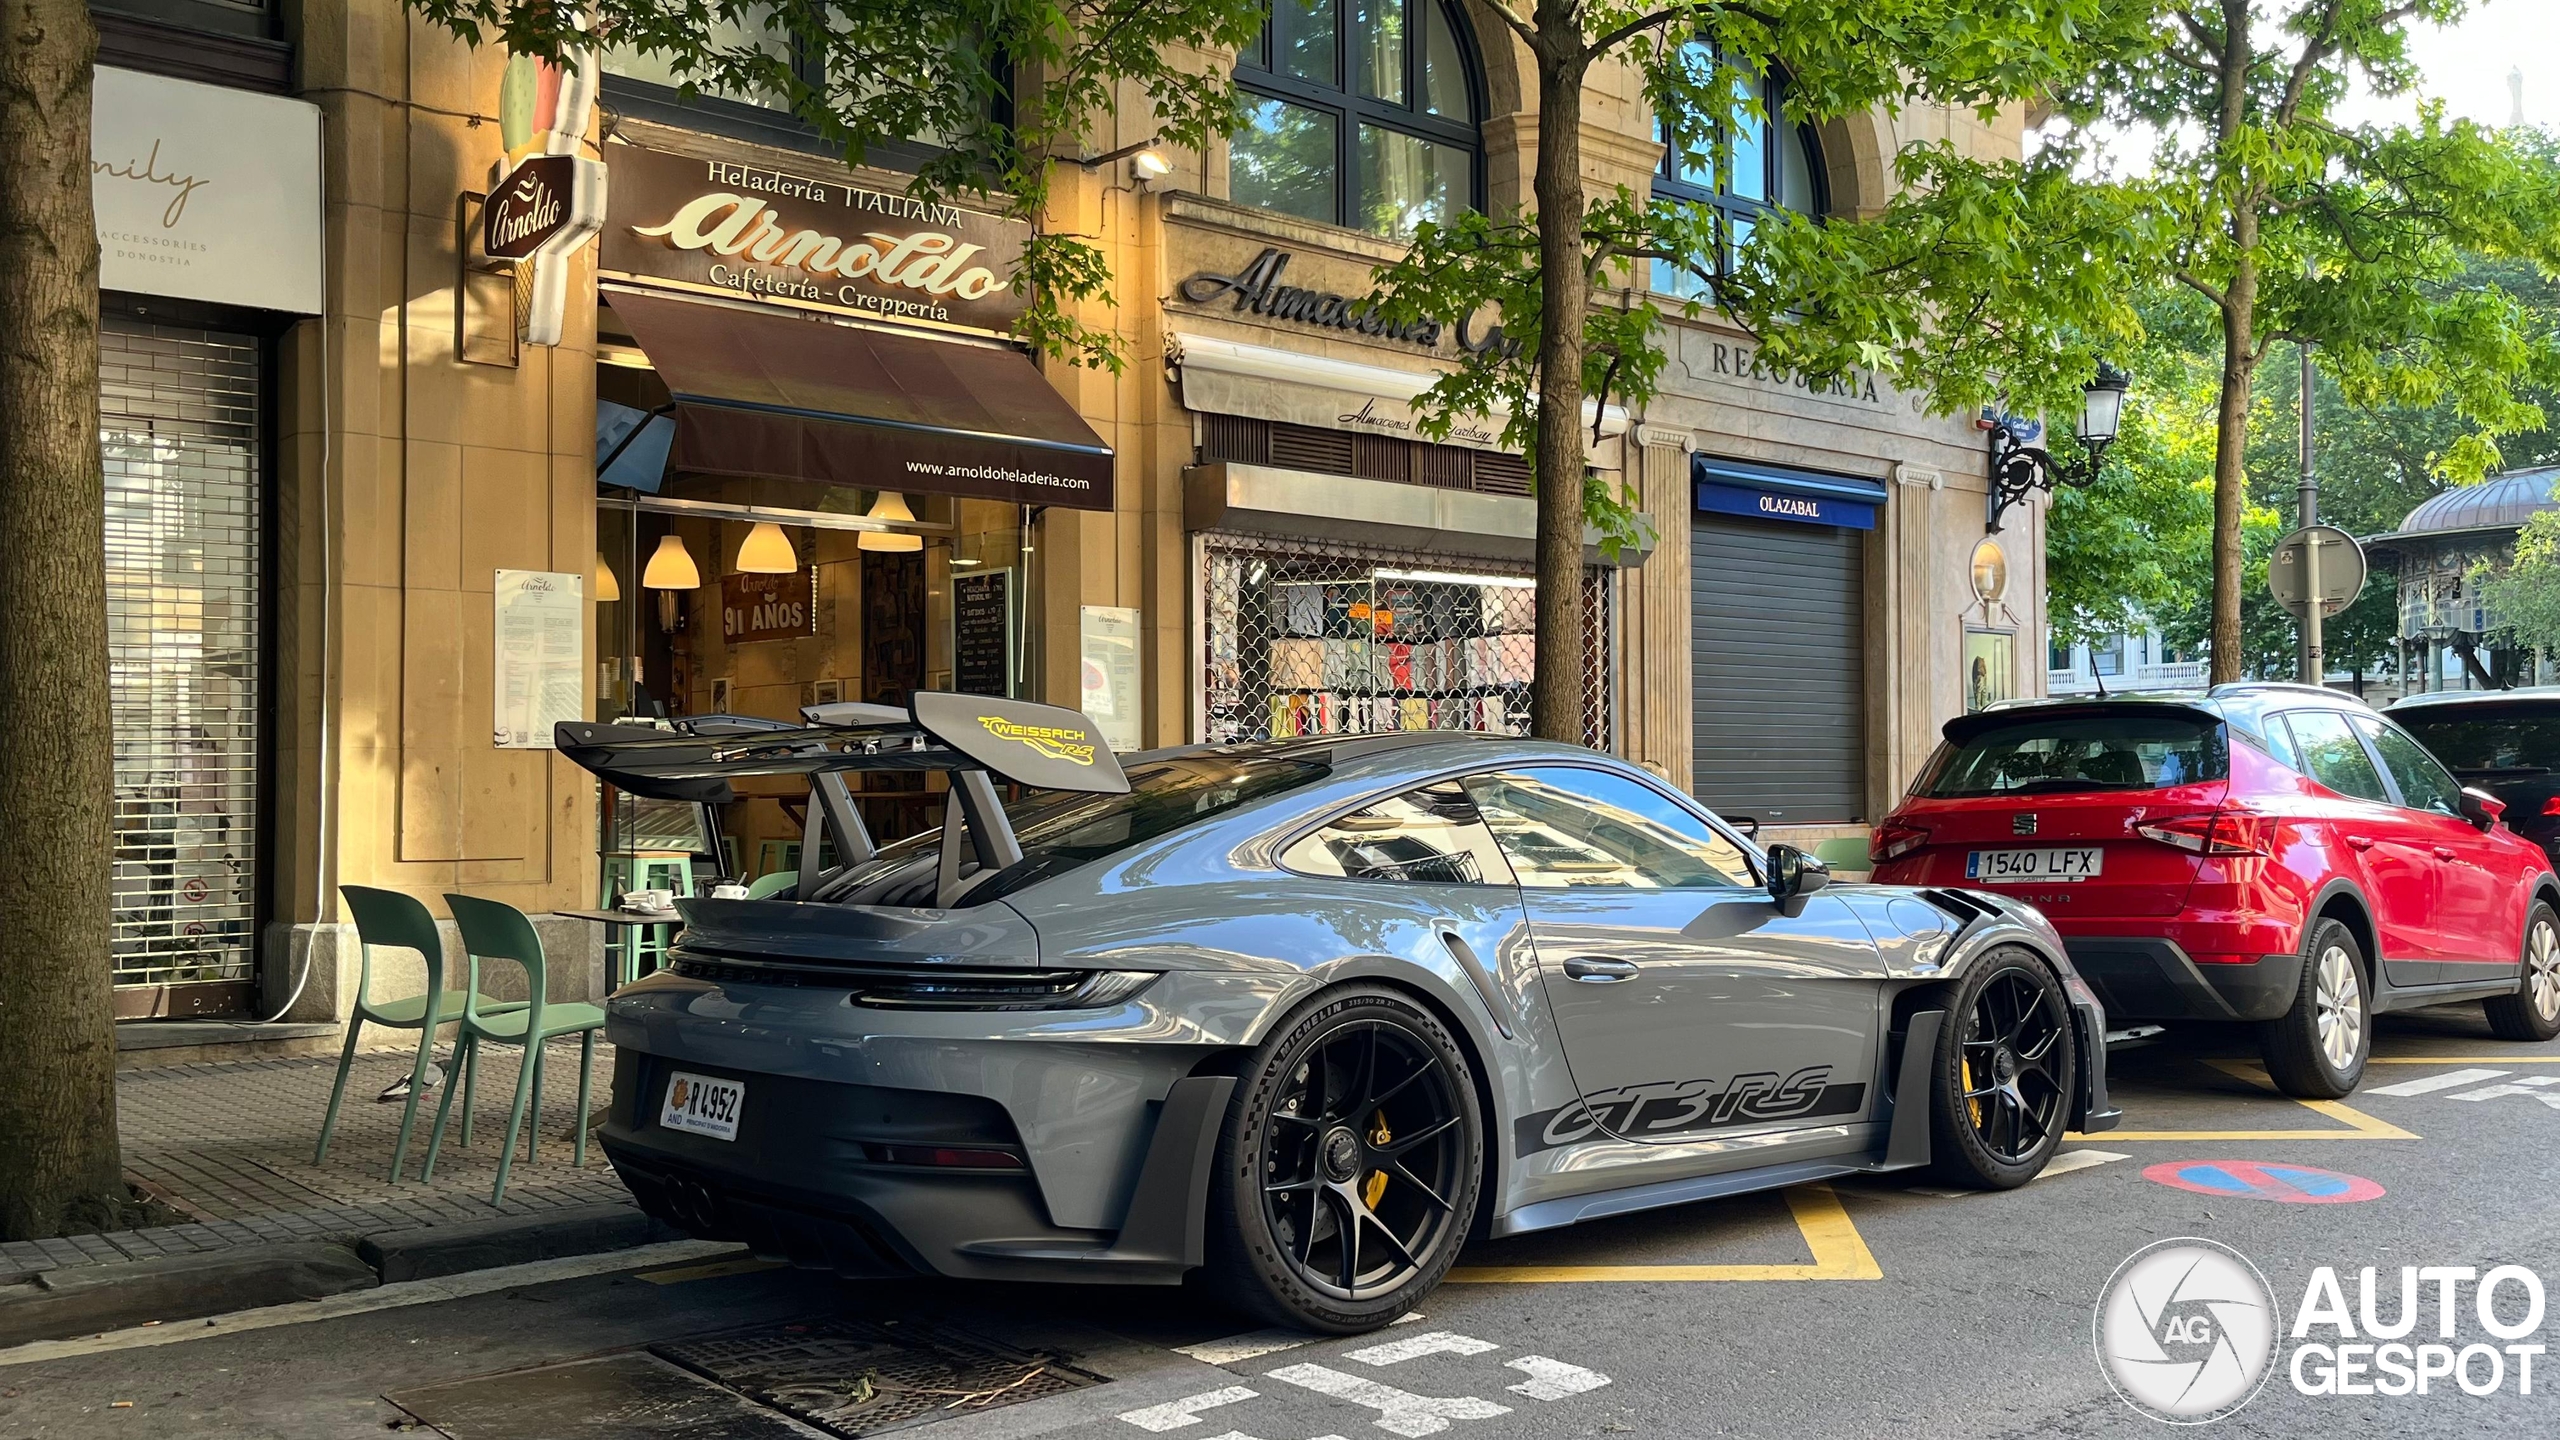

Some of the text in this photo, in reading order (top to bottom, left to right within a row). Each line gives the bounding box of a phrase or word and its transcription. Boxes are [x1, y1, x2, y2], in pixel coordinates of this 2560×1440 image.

[708, 161, 963, 229] Heladería ITALIANA
[492, 182, 561, 249] Arnoldo
[101, 231, 207, 252] ACCESSORIES
[117, 250, 191, 266] DONOSTIA
[1338, 397, 1493, 447] Almacenes aribay
[906, 461, 1090, 490] www.arnoldoheladeria.com
[1759, 496, 1820, 517] OLAZABAL
[725, 592, 804, 636] 91 AÑOS
[996, 723, 1085, 741] WEISSACH
[1060, 743, 1095, 756] RS
[1986, 850, 2094, 875] 1540 LFX
[1279, 1001, 1343, 1059] MICHELIN
[700, 1084, 738, 1123] 4952
[667, 1113, 683, 1125] AND
